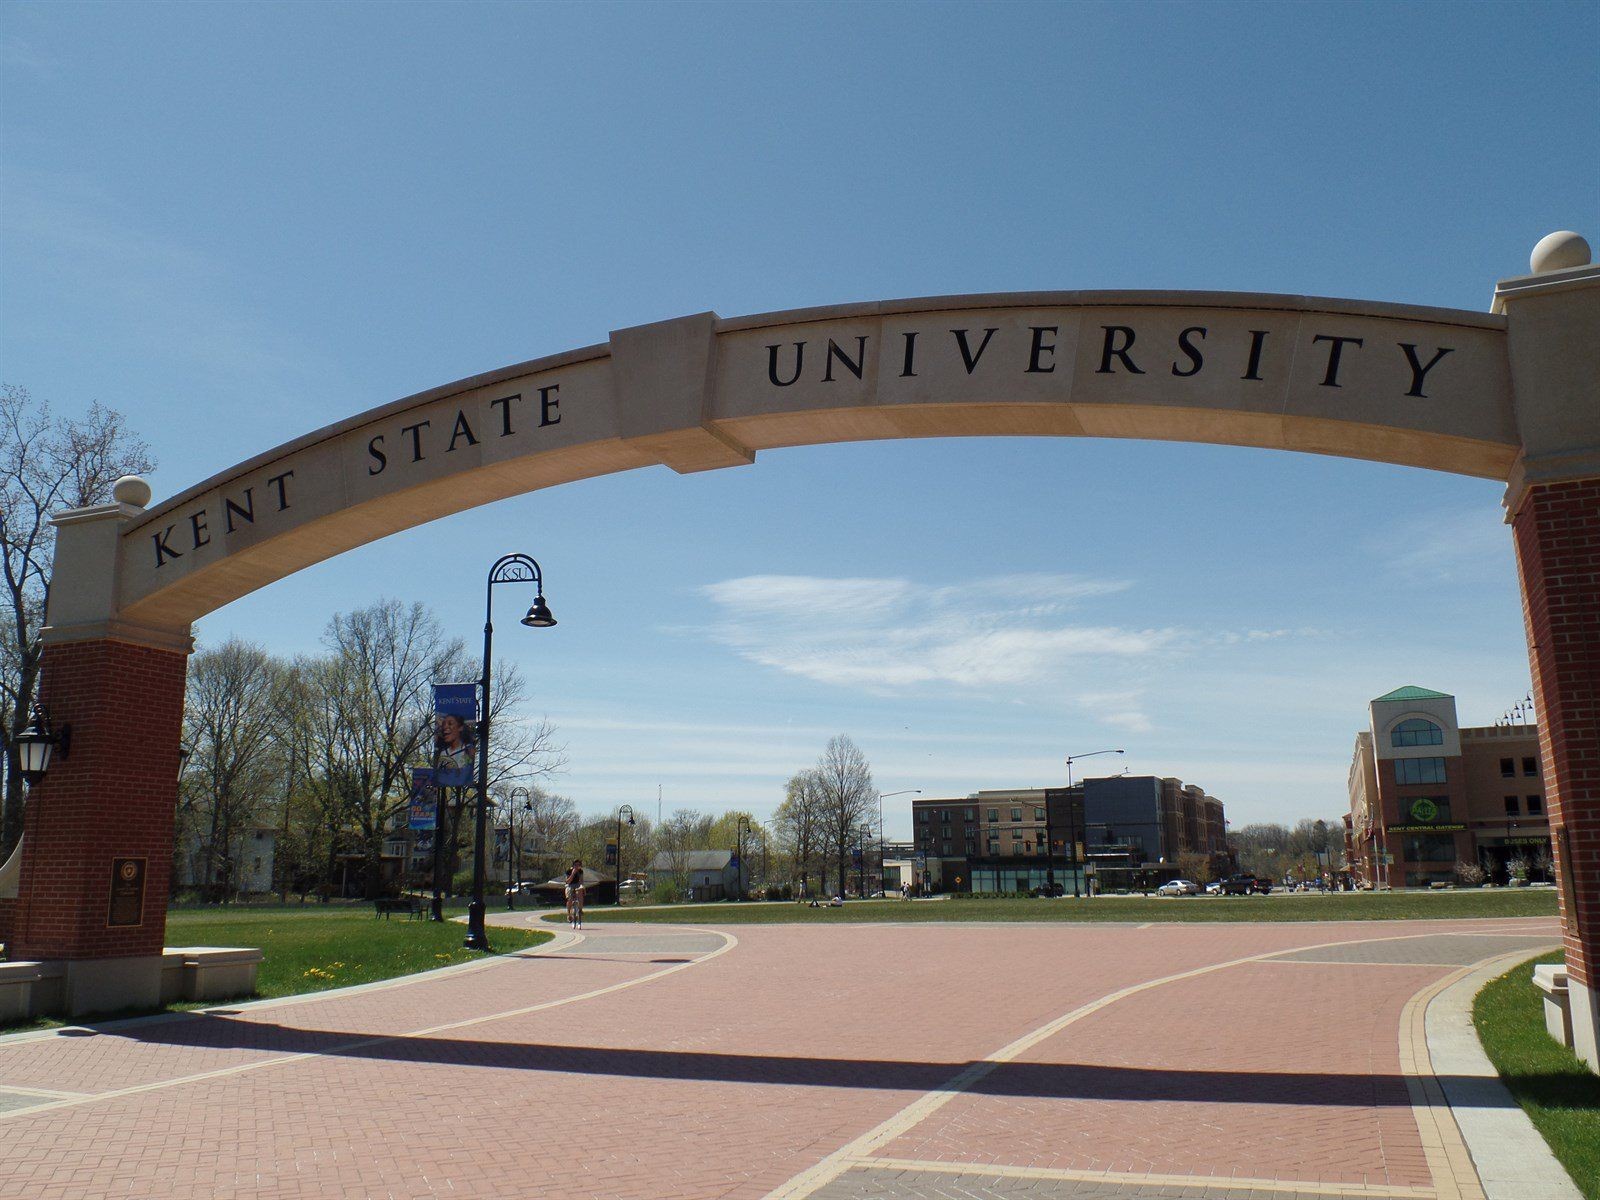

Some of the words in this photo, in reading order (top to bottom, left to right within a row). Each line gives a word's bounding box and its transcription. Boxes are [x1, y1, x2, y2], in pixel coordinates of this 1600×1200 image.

[152, 470, 295, 569] KENT
[368, 384, 562, 476] STATE
[765, 325, 1456, 399] UNIVERSITY
[502, 567, 528, 581] KSU
